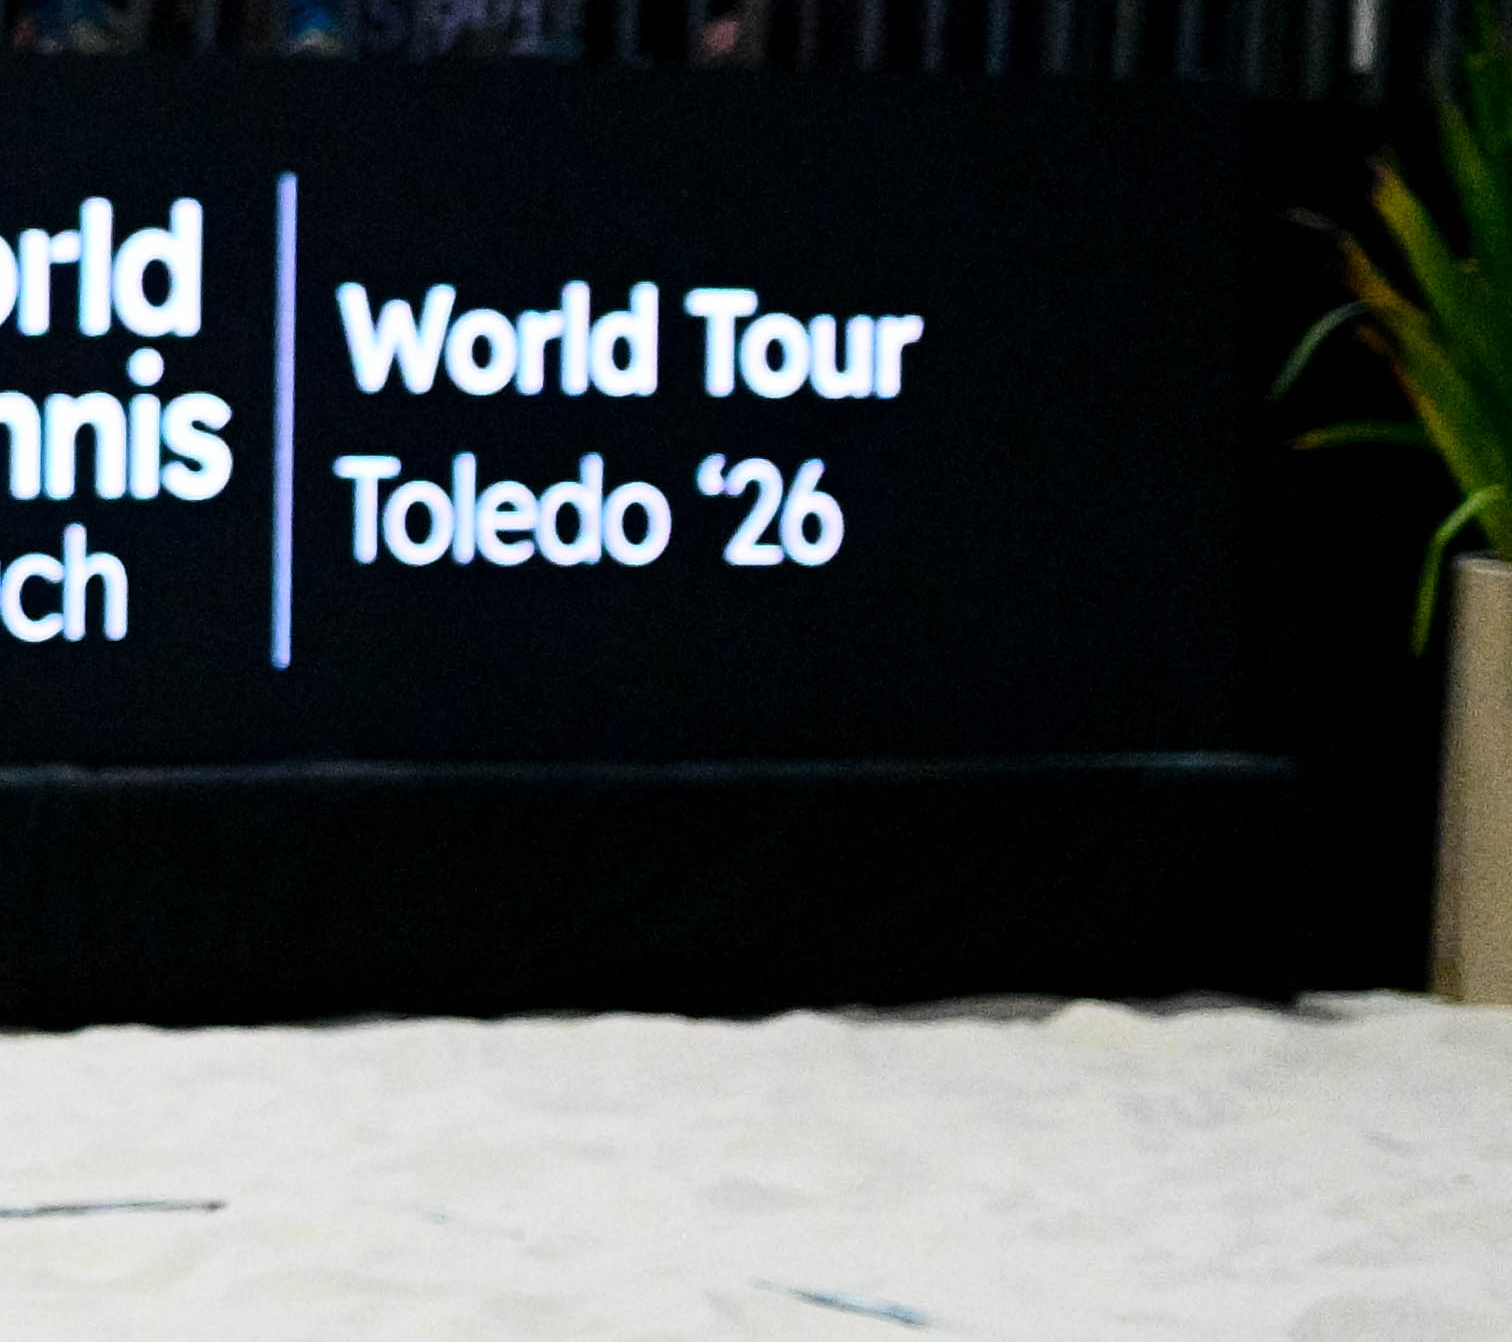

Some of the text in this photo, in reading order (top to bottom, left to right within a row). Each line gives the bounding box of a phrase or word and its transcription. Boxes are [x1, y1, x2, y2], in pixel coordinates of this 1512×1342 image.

[337, 280, 924, 400] World Tour
[333, 452, 672, 567] Toledo
